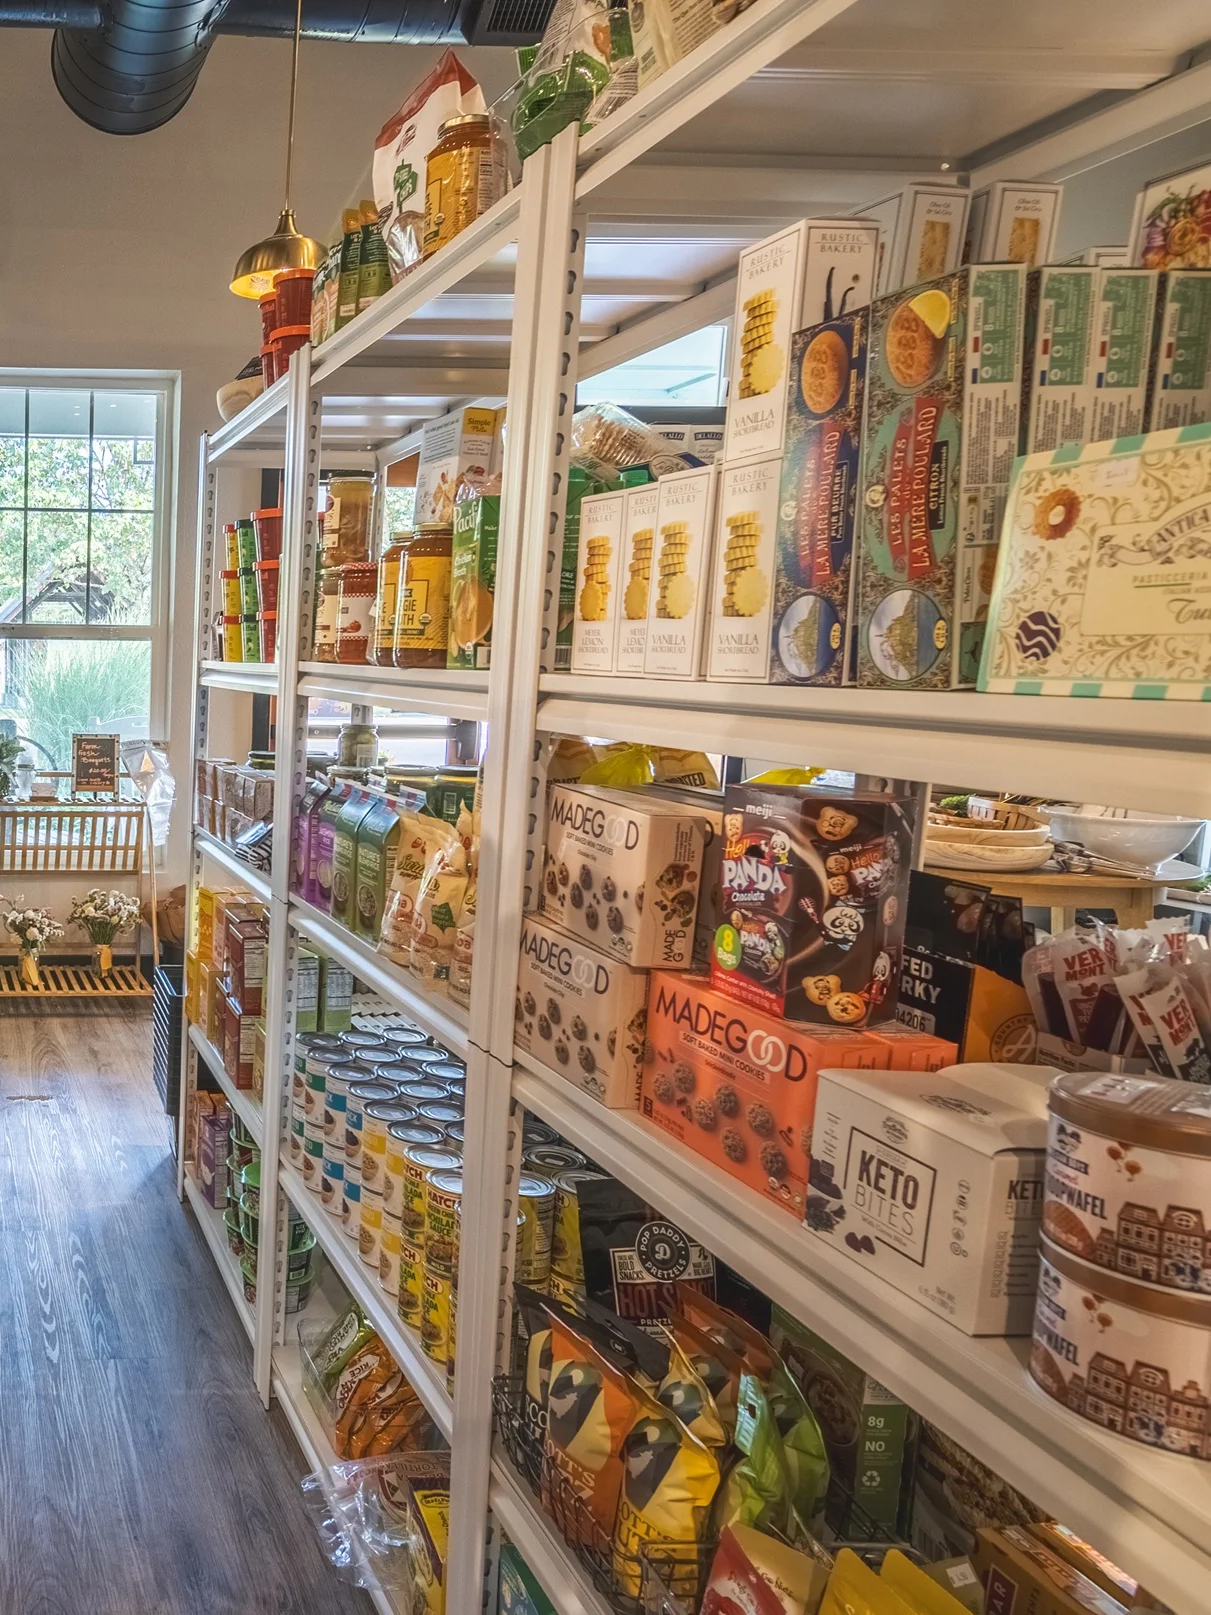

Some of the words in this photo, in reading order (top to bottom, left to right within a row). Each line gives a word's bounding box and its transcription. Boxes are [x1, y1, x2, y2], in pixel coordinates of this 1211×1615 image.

[821, 233, 865, 243] RUSTIC
[750, 244, 786, 267] RUSTIC
[820, 244, 864, 255] BAKERY
[749, 257, 785, 280] BAKERY
[734, 407, 776, 429] VANILLA
[912, 406, 937, 490] POULARD
[733, 468, 769, 483] RUSTIC
[819, 431, 841, 506] POULARD
[891, 438, 907, 507] PALETS
[667, 481, 698, 495] RUSTIC
[731, 481, 768, 496] BAKERY
[929, 463, 940, 510] CITRON
[588, 503, 614, 515] RUSTIC
[635, 494, 657, 506] RUSTI
[666, 494, 696, 506] BAKERY
[588, 513, 613, 525] BAKERY
[633, 505, 657, 517] BAKER
[891, 512, 903, 546] LES
[816, 555, 831, 576] LA
[912, 547, 931, 567] LA
[581, 636, 604, 647] LEMON
[585, 629, 602, 637] MEYER
[651, 633, 687, 646] VANILLA
[718, 634, 759, 645] VANILLA
[651, 645, 687, 654] SHORTBREAD
[717, 645, 760, 655] SHORTBREAD
[81, 741, 101, 750] Farm
[746, 804, 774, 819] meiji
[551, 796, 640, 851] MADEGOOD
[839, 844, 863, 854] meiji
[851, 852, 881, 868] Hello
[722, 857, 787, 895] PANDA
[731, 891, 766, 902] Chocolate
[663, 929, 676, 963] MADE
[723, 929, 734, 951] 8
[717, 947, 737, 966] Bags
[1063, 947, 1105, 971] VER
[1065, 963, 1108, 982] MONT
[563, 979, 582, 997] COOKIES
[1160, 999, 1190, 1030] VER
[655, 985, 808, 1083] MADEGOOD
[1168, 1012, 1196, 1047] MONT
[681, 1031, 697, 1045] SOFT
[698, 1037, 719, 1056] BAKED
[719, 1048, 734, 1063] MINI
[735, 1056, 766, 1081] COOKIES
[858, 1149, 920, 1211] KETO
[855, 1183, 915, 1237] BITES
[639, 1230, 651, 1252] POP
[652, 1226, 686, 1249] DADDY
[618, 1260, 635, 1271] BOLD
[644, 1258, 687, 1280] PRETZELS
[619, 1270, 645, 1282] SNACKS
[618, 1284, 658, 1319] HOT
[867, 1415, 885, 1429] 8g
[864, 1440, 886, 1453] NO
